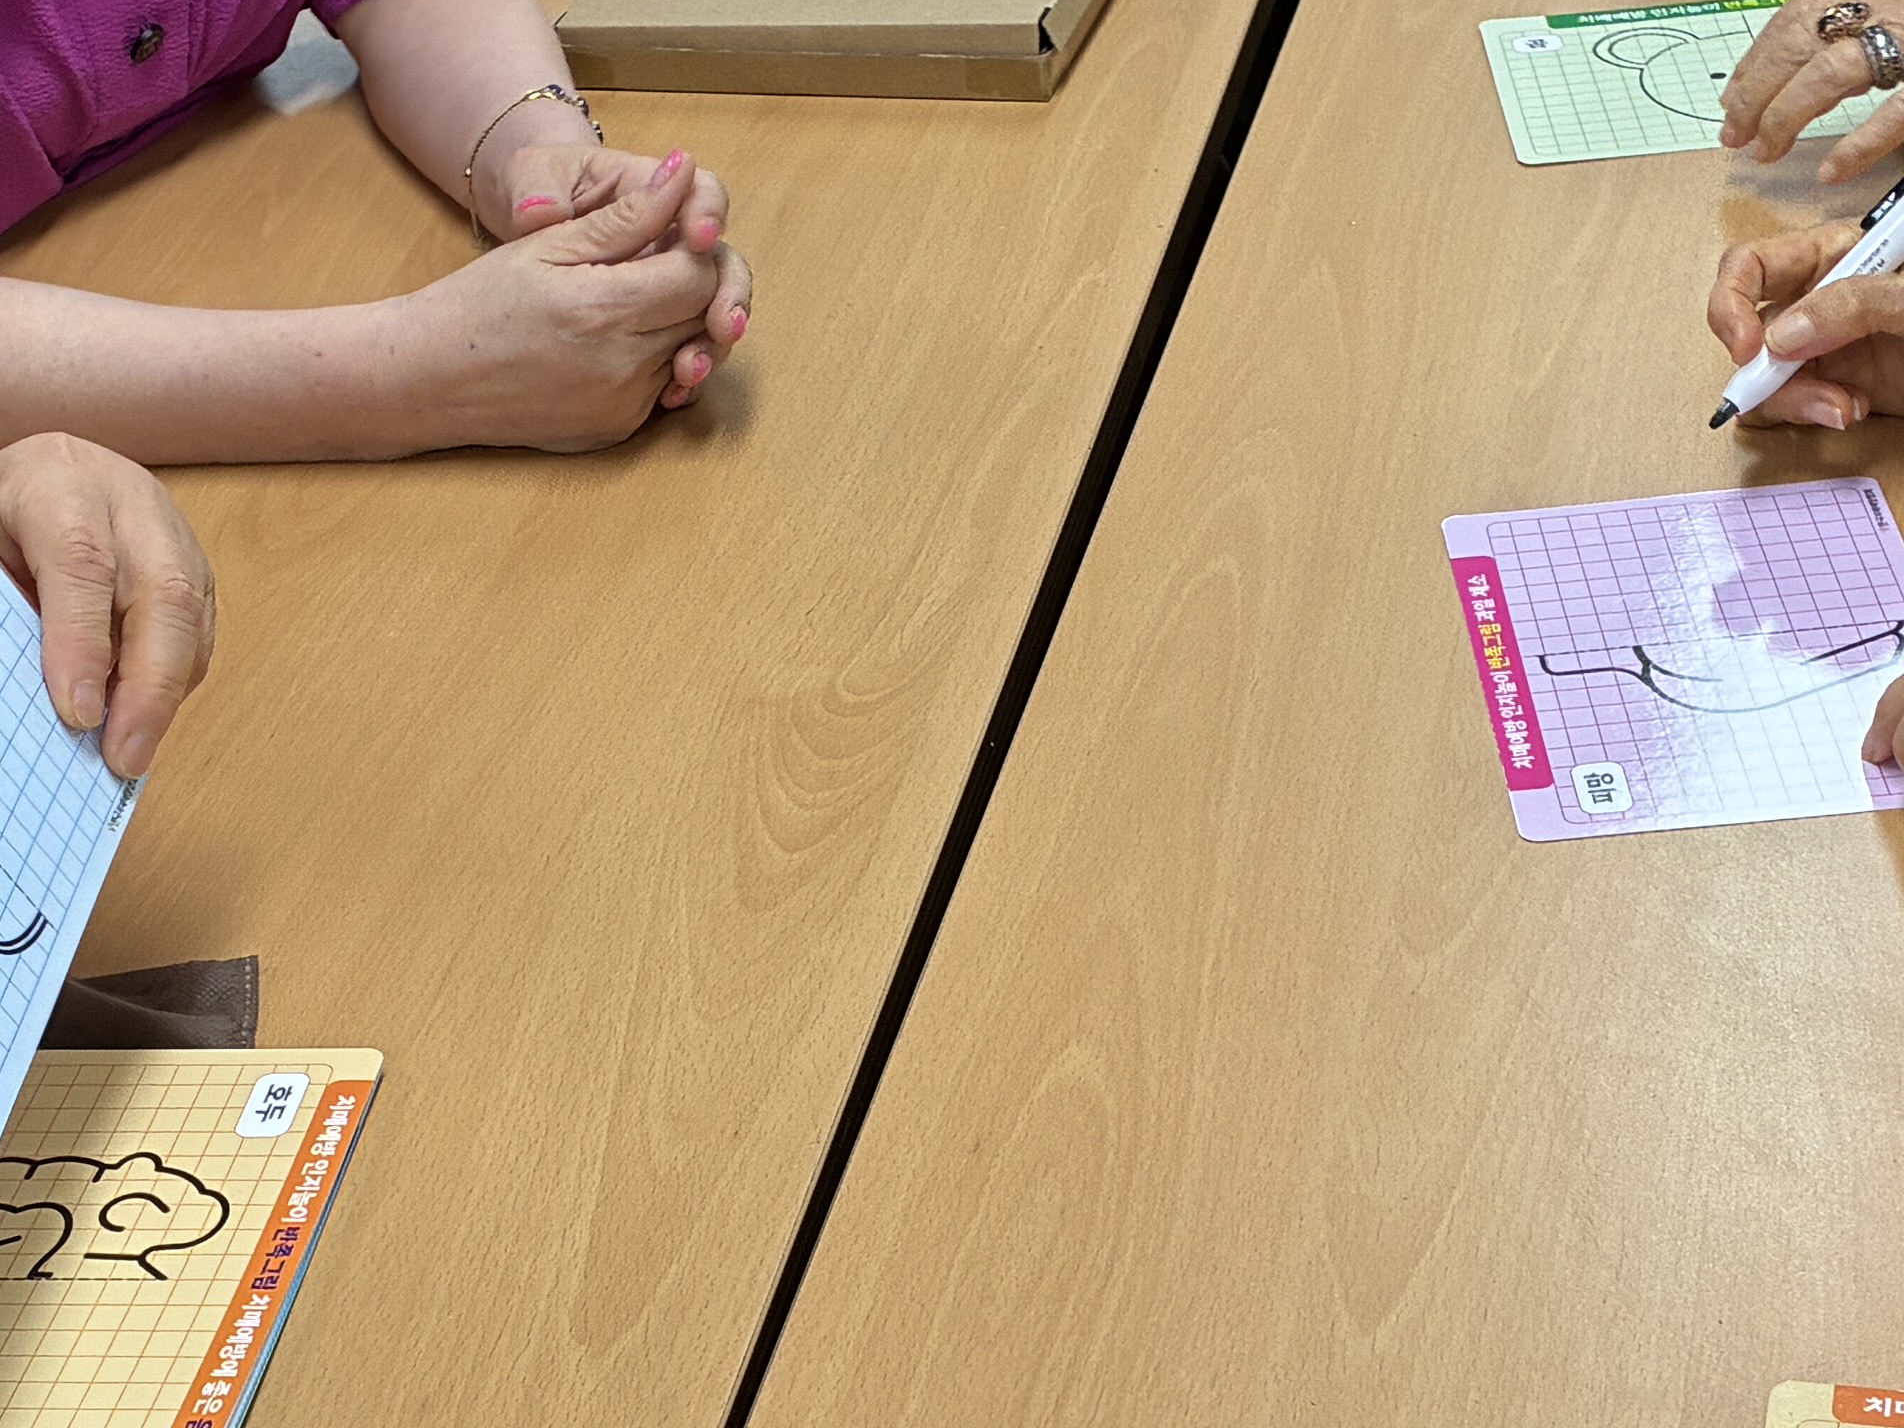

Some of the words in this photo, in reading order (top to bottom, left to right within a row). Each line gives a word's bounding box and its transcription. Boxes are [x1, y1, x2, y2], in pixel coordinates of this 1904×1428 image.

[1467, 573, 1491, 598] 채소
[1471, 597, 1497, 622] 과일
[1477, 622, 1512, 670] 반쪽그림
[1489, 670, 1524, 719] 인지놀이
[1501, 720, 1536, 770] 치매예방
[1582, 772, 1616, 806] 피망
[254, 1082, 293, 1124] 호두
[309, 1093, 356, 1156] 치매예방
[281, 1158, 328, 1224] 인지놀이
[250, 1225, 301, 1291] 반쪽그림
[209, 1293, 271, 1378] 치매예방에
[192, 1380, 232, 1415] 좋은
